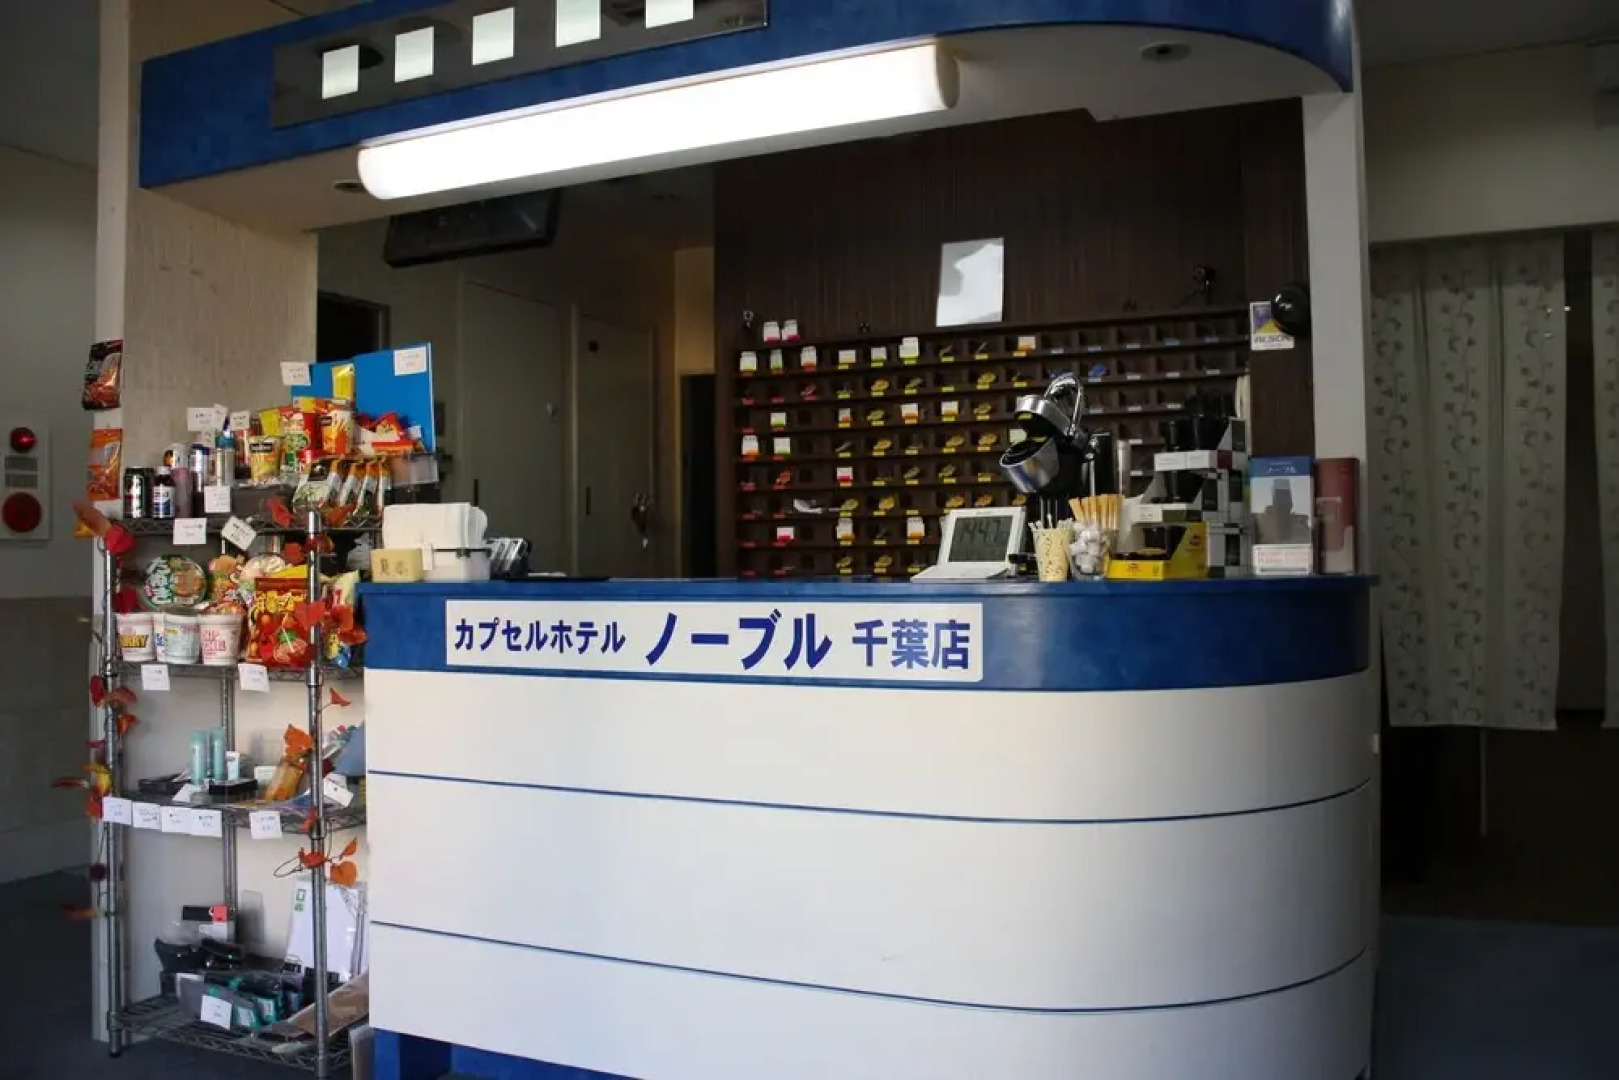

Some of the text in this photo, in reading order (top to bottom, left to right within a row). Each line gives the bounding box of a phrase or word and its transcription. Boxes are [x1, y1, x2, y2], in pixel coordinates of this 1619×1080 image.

[454, 607, 972, 670] カプセルホテル ノーブル 千葉店
